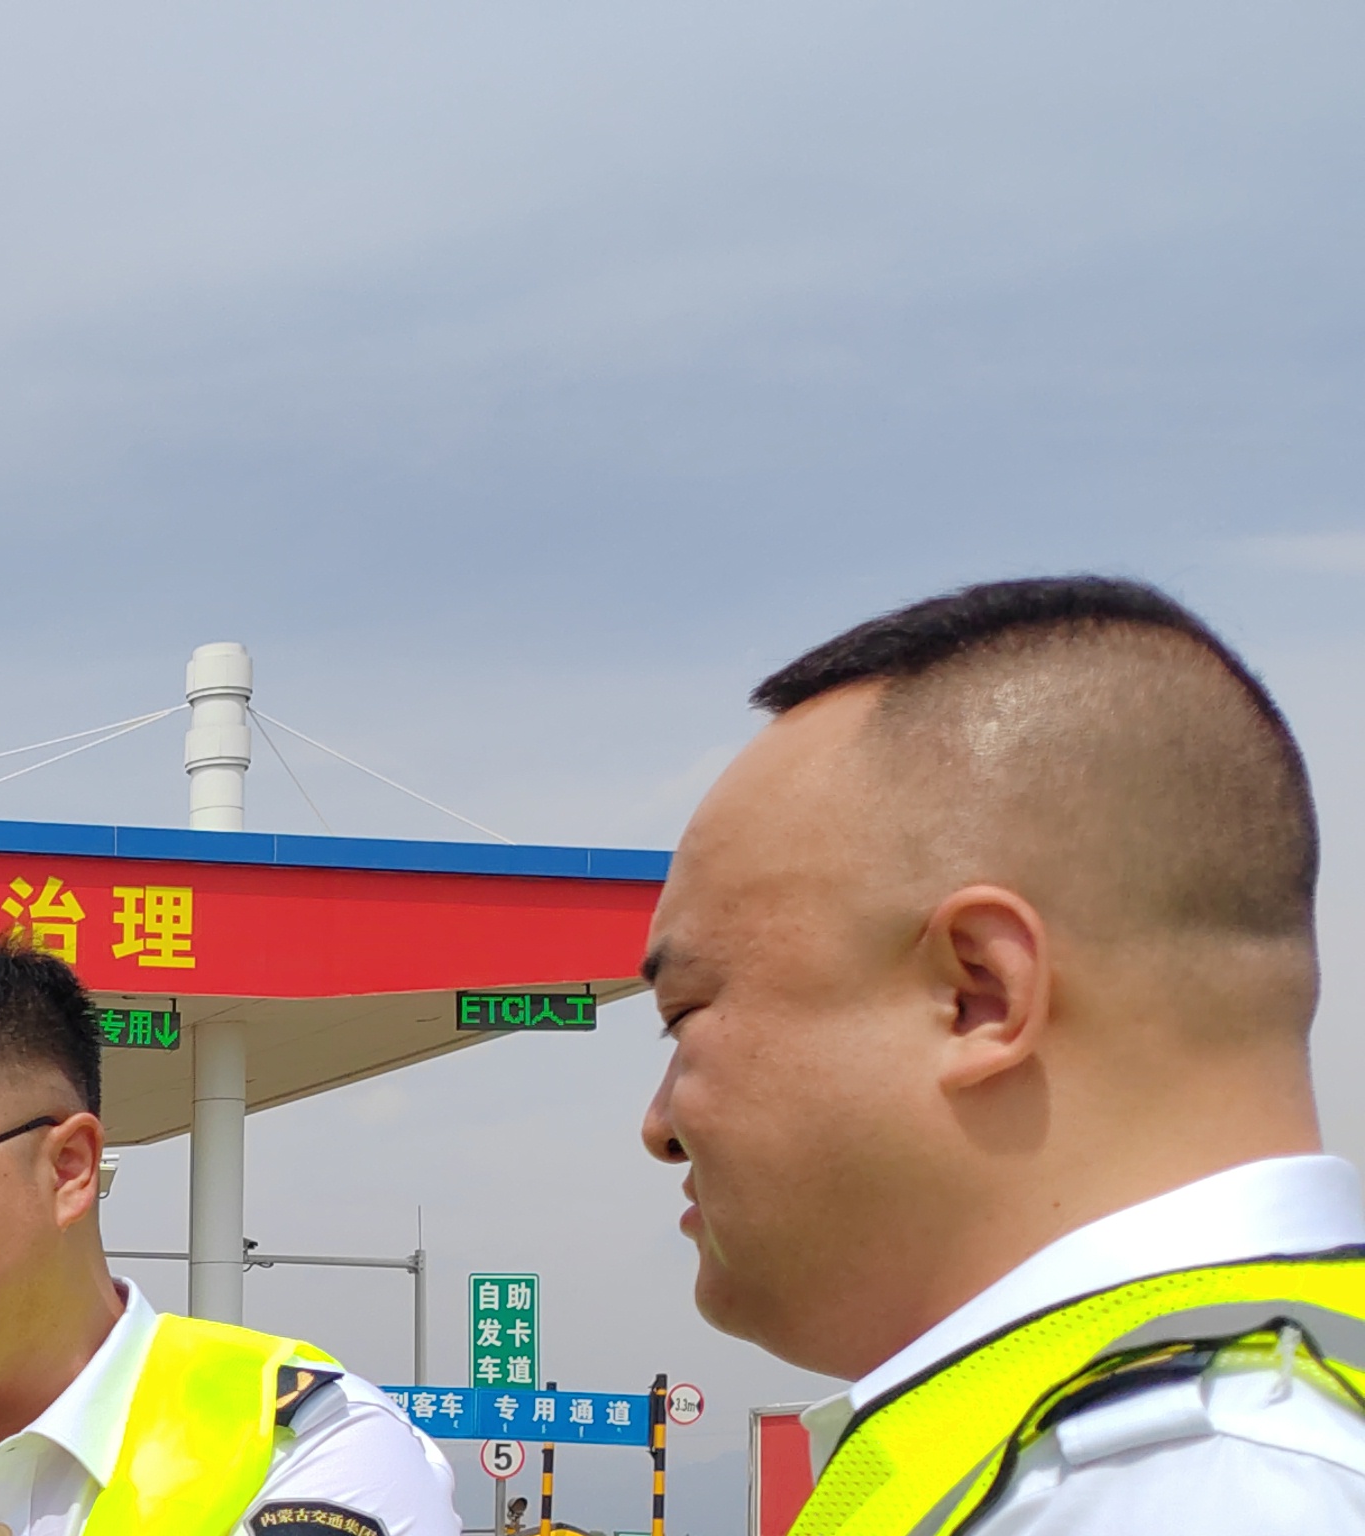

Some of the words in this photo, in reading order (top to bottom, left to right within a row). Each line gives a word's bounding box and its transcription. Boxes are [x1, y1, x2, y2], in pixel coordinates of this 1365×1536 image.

[478, 1282, 532, 1311] 自助
[477, 1318, 532, 1348] 发卡
[476, 1355, 533, 1384] 车道
[493, 1394, 631, 1425] 专用通道
[674, 1397, 697, 1413] 3.3m
[493, 1443, 513, 1471] 5
